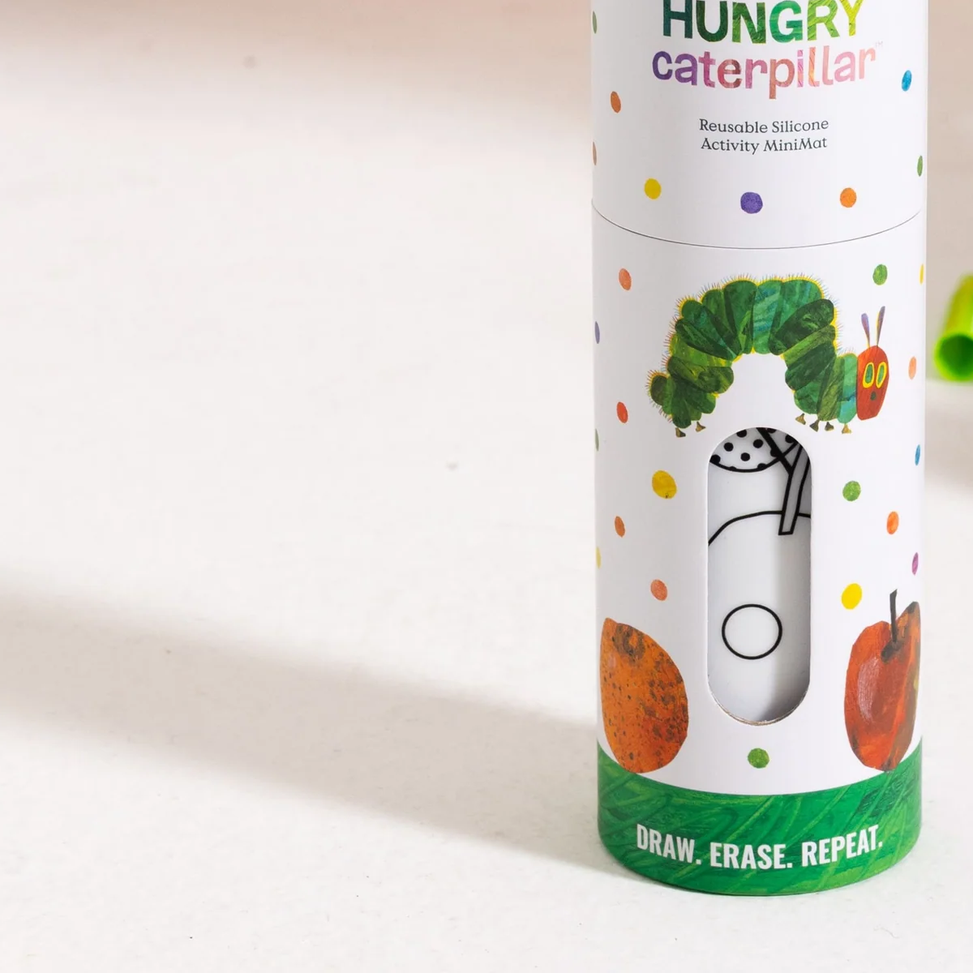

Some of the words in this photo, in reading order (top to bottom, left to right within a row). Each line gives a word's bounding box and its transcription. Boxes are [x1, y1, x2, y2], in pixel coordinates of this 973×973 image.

[699, 118, 768, 134] Reusable
[772, 118, 829, 133] Silicone
[701, 137, 760, 155] Activity
[763, 137, 828, 152] MiniMat
[636, 823, 702, 865] DRAW.
[710, 842, 793, 870] ERASE.
[801, 824, 883, 867] REPEAT.
